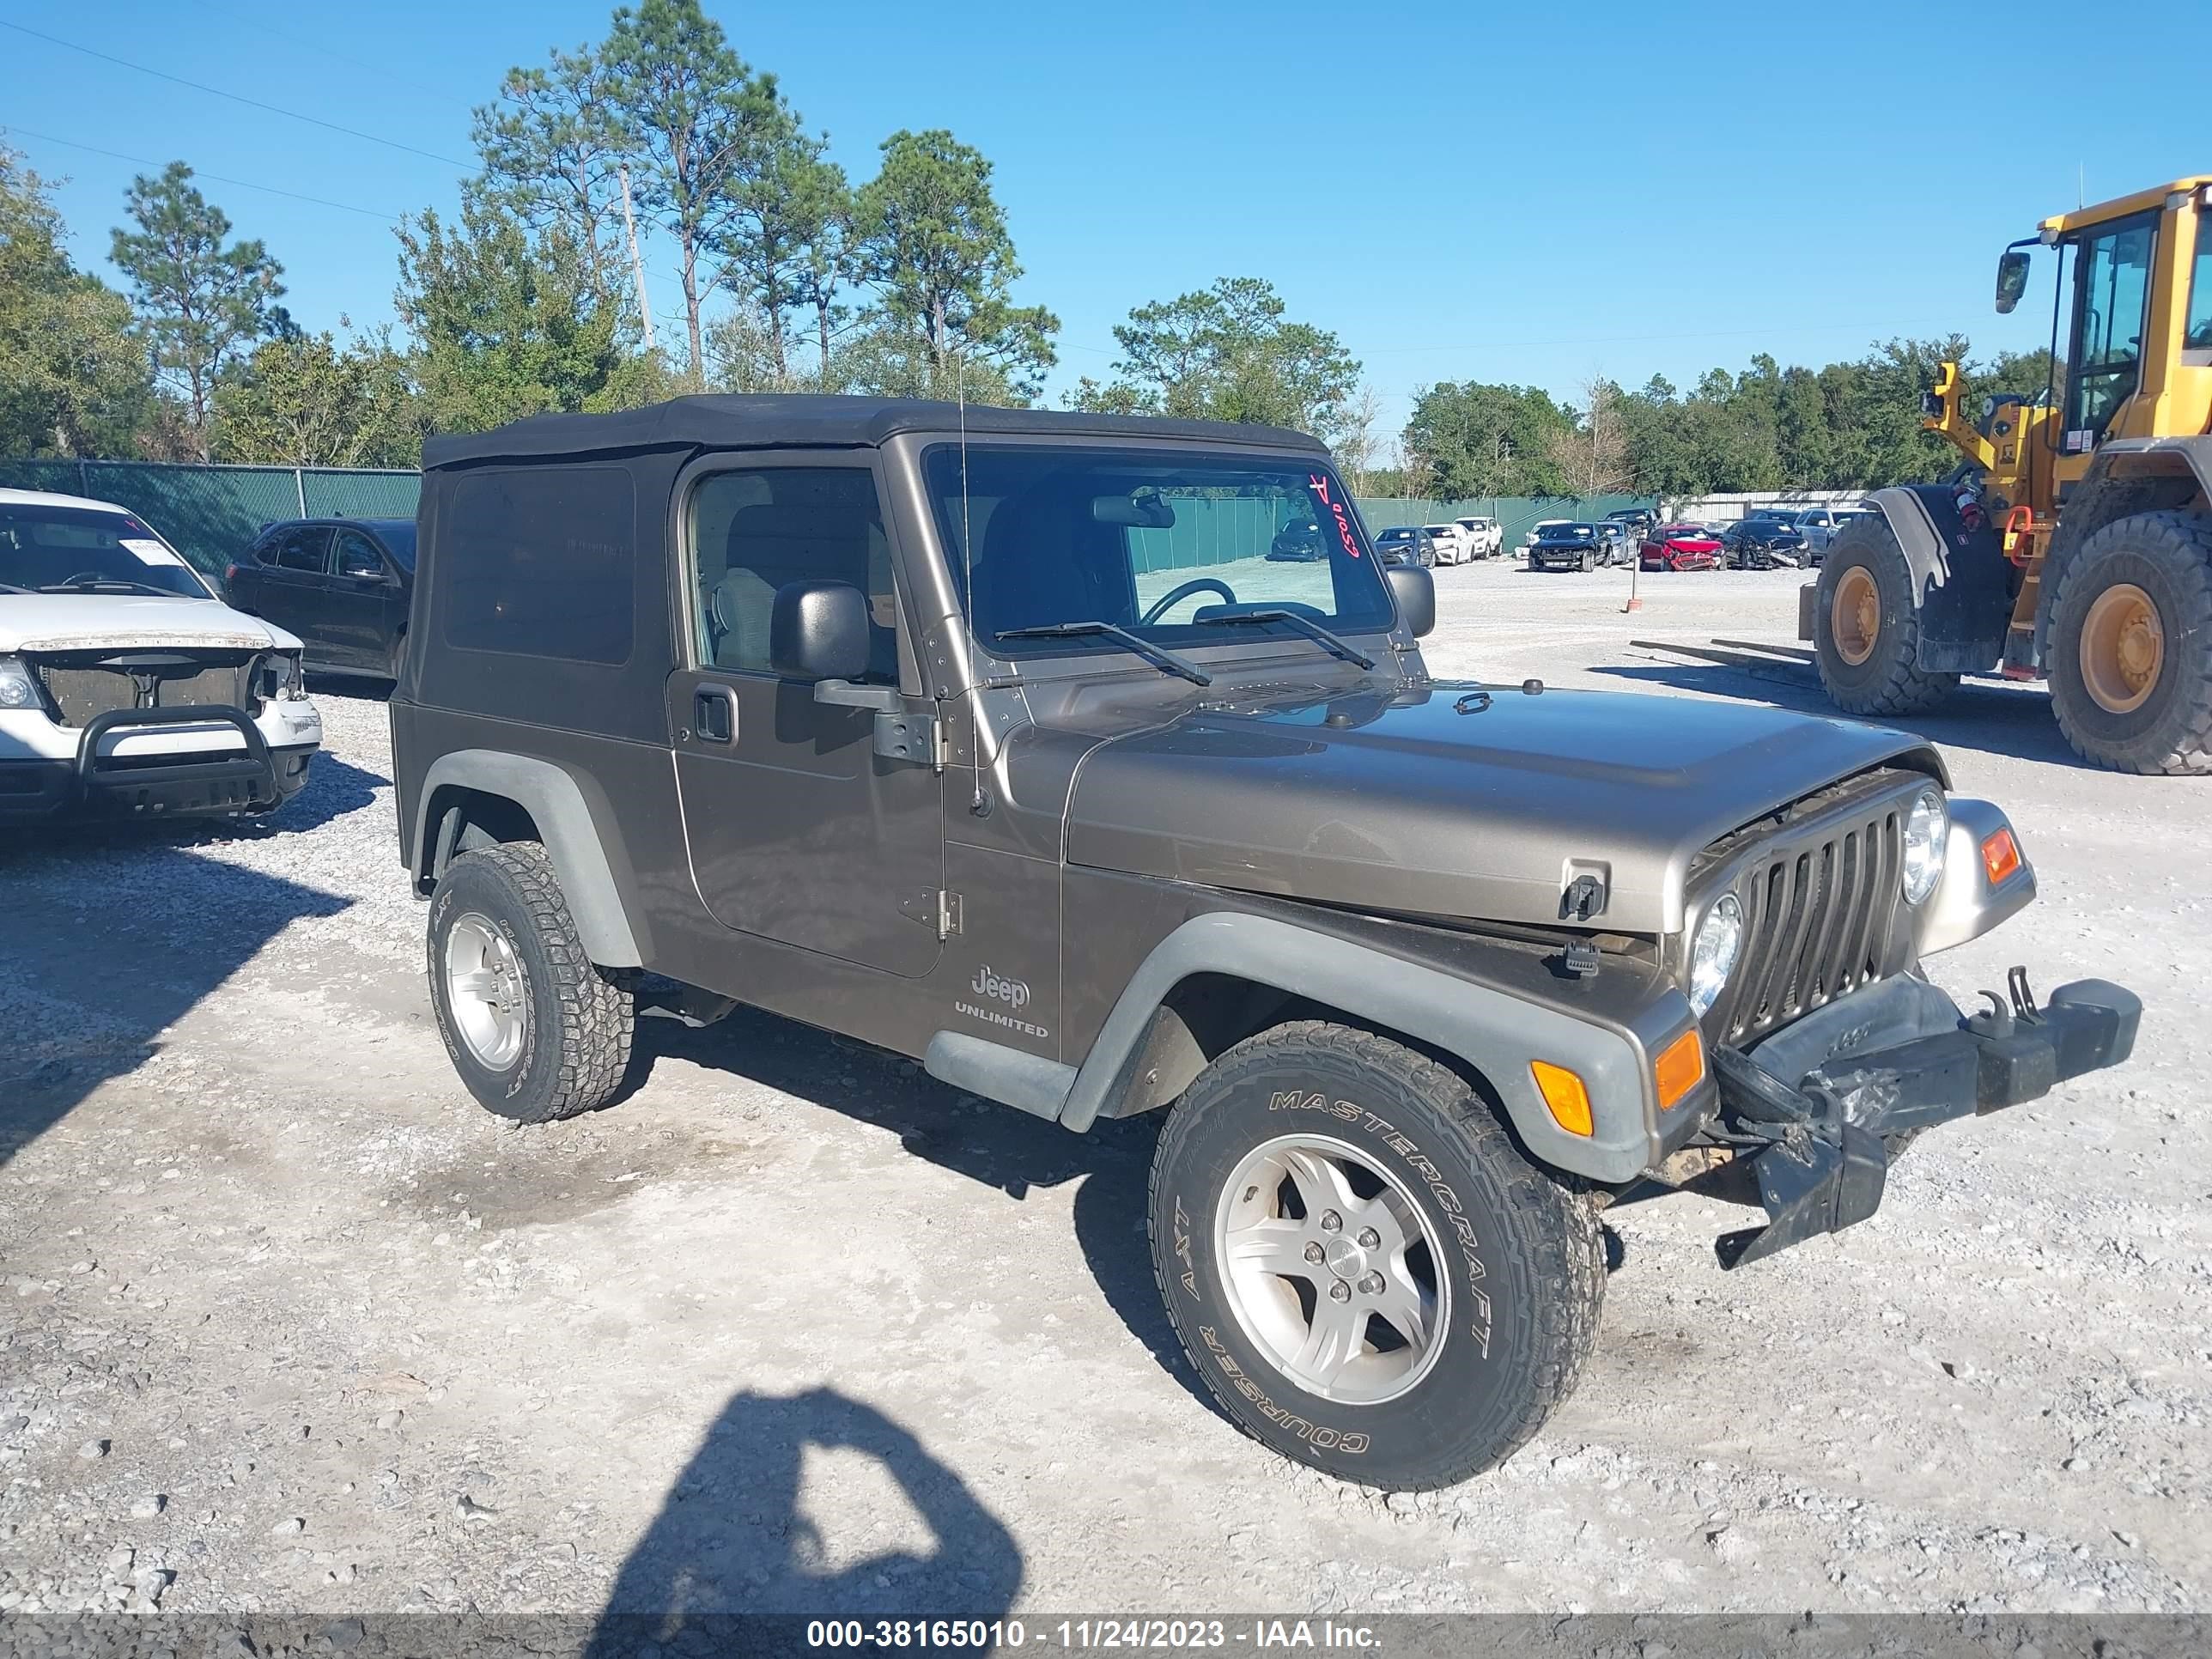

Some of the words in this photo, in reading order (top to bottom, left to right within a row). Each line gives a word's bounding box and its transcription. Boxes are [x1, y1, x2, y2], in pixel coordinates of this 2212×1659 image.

[954, 1001, 1048, 1038] UNLIMITED
[971, 964, 1030, 1008] Jeep
[1268, 1090, 1492, 1360] MASTERCRAFT
[1199, 1325, 1370, 1454] COURSER
